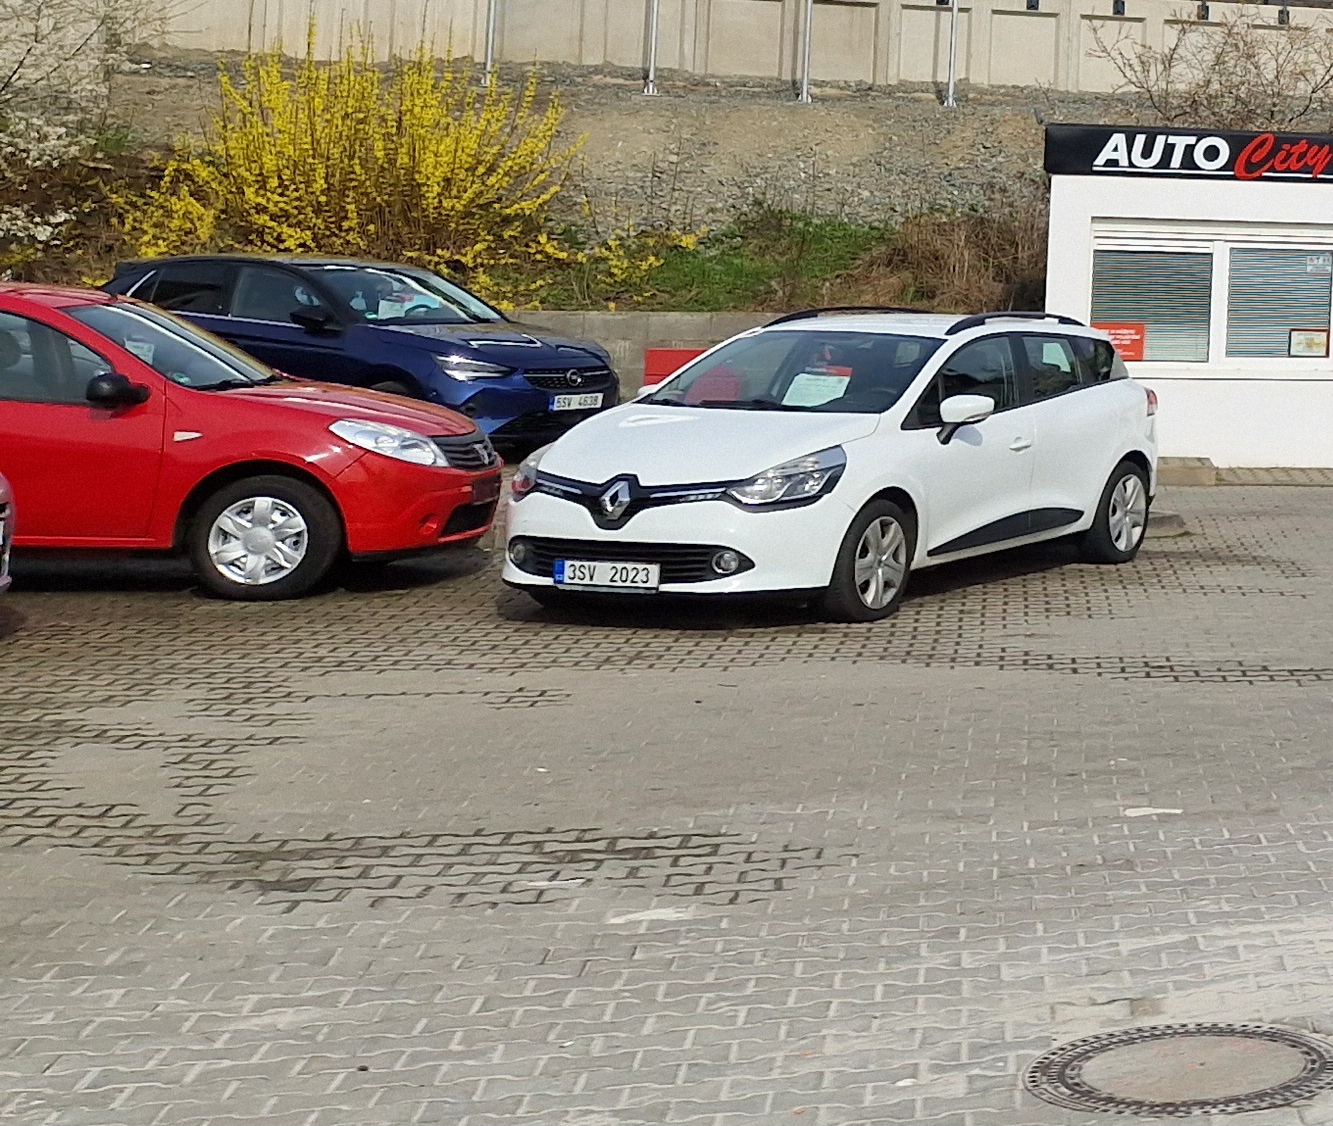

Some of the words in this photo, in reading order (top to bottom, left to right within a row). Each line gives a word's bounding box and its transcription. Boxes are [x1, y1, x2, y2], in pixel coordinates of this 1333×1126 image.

[1094, 132, 1231, 171] AUTO
[1234, 133, 1333, 180] City
[568, 564, 596, 582] 3SV
[609, 566, 650, 584] 2023
